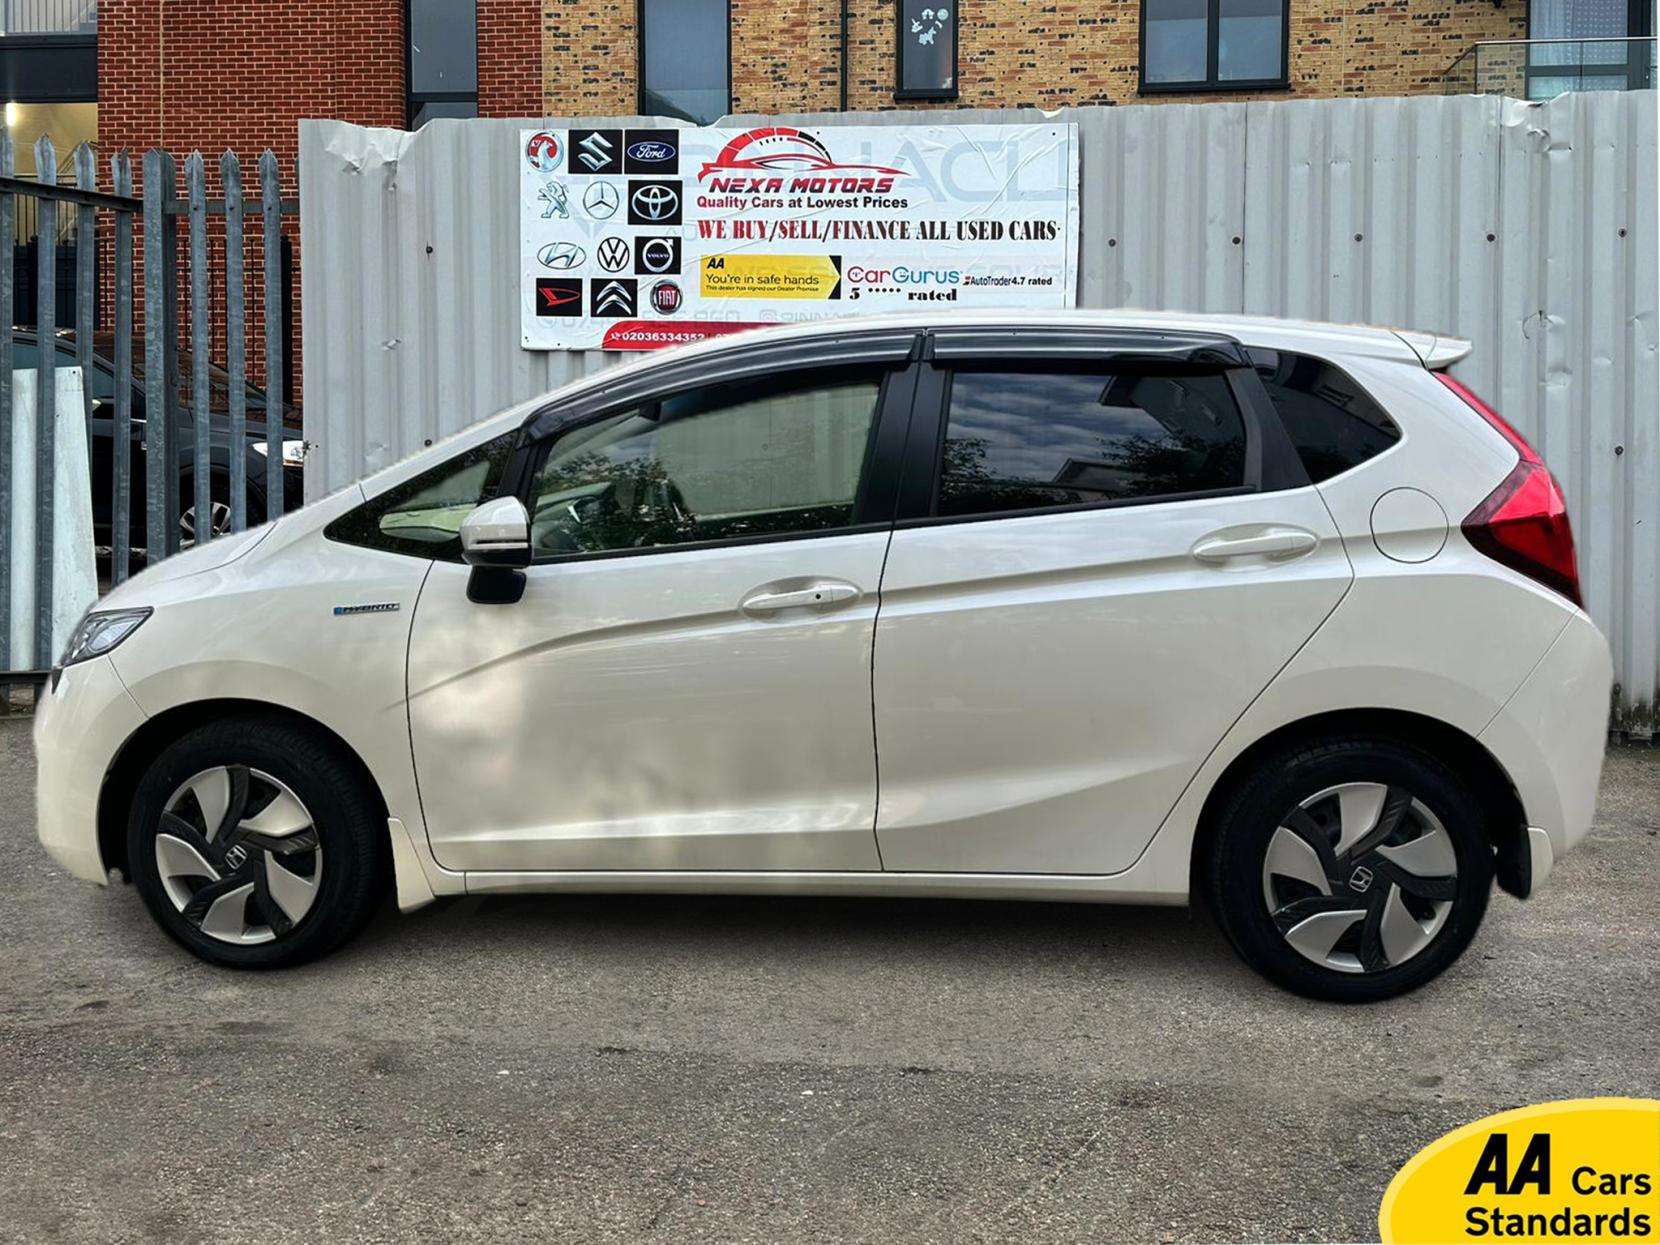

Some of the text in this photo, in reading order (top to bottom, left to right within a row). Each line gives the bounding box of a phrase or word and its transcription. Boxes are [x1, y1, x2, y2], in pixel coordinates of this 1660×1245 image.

[636, 144, 666, 158] Ford
[709, 177, 894, 193] NEXA MOTORS
[697, 196, 908, 211] Quality Cars at Lowest Prices
[697, 219, 726, 239] WE
[916, 220, 950, 240] ALL
[956, 220, 1004, 240] USED
[706, 257, 725, 269] AA
[705, 273, 820, 285] You're in safe hands
[847, 265, 960, 284] CarGurus
[1011, 276, 1026, 286] 4.7
[1028, 276, 1053, 286] rated
[658, 290, 677, 306] FIAT
[849, 287, 957, 301] 5 rated
